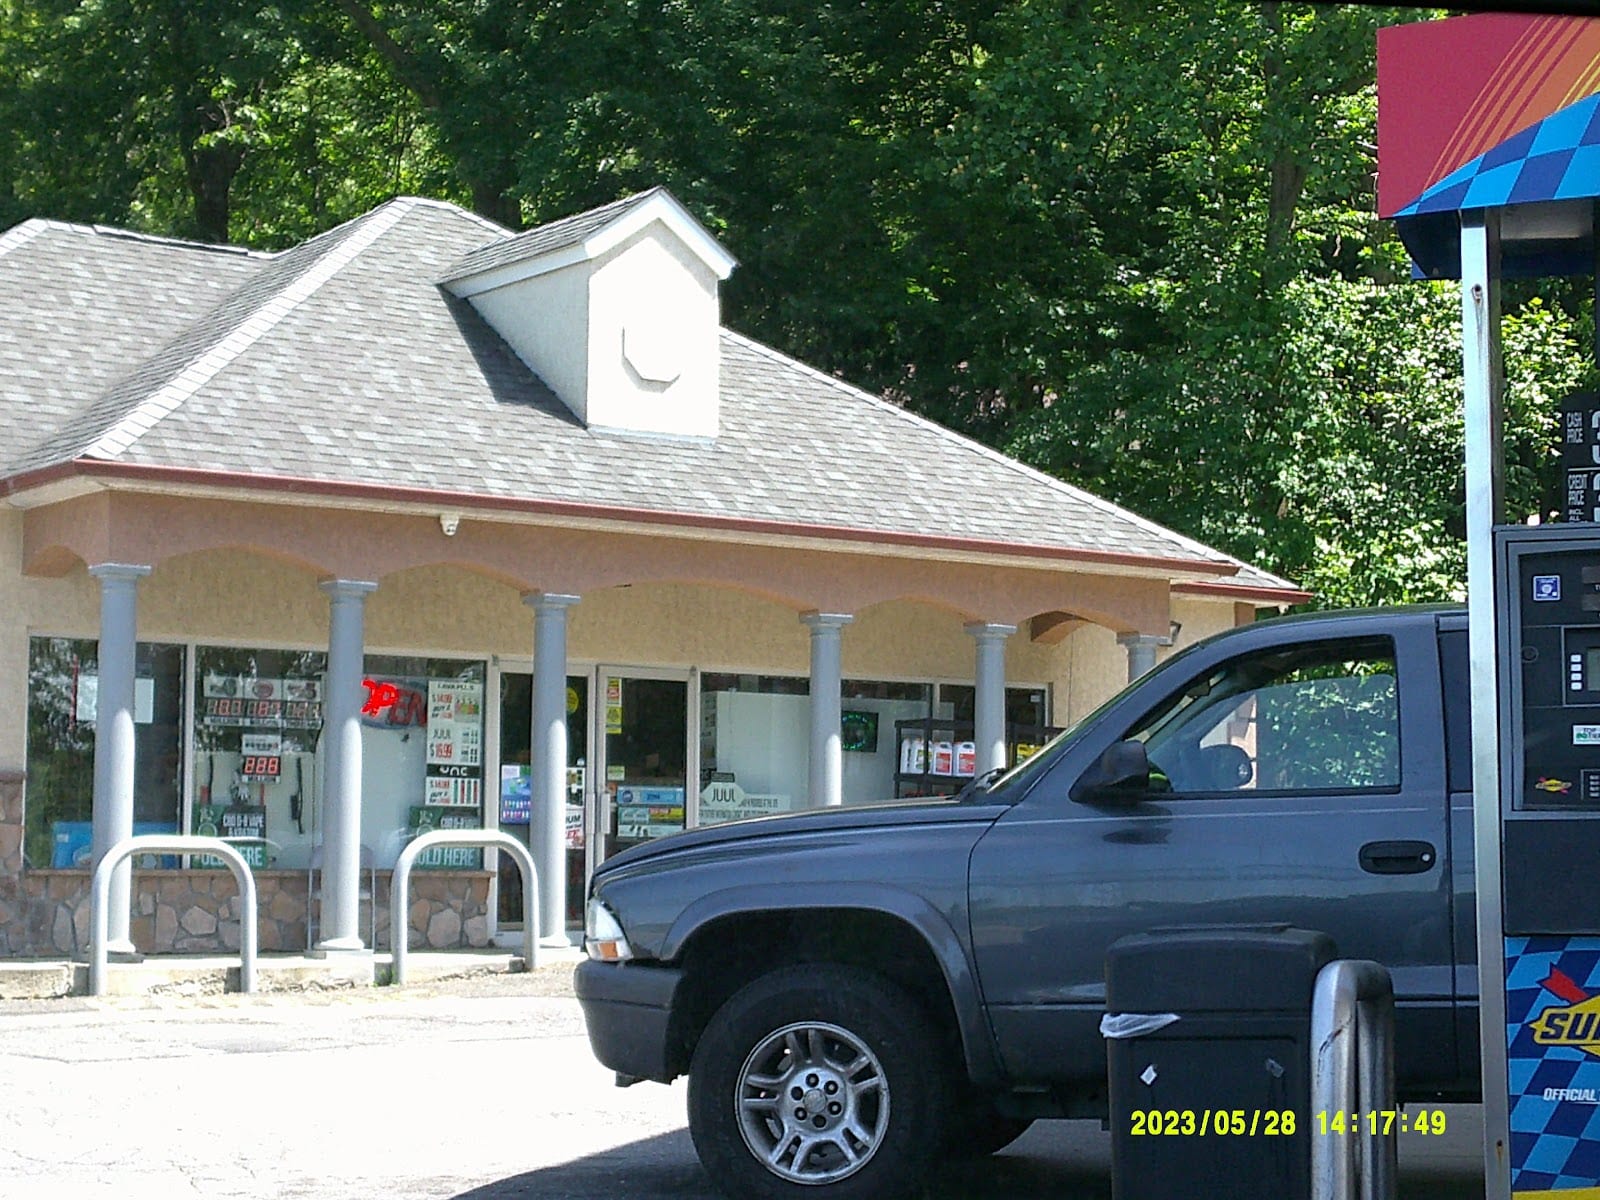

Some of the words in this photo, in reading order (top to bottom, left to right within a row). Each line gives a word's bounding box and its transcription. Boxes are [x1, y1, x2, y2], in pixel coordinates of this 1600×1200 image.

[1566, 411, 1583, 428] CASH
[1567, 428, 1584, 444] PRICE
[1568, 473, 1588, 490] CREDIT
[1568, 490, 1585, 506] PRICE
[413, 848, 441, 865] OLD
[443, 847, 474, 866] HERE
[1540, 1013, 1600, 1040] SU
[1543, 1087, 1597, 1101] OFFICIAL
